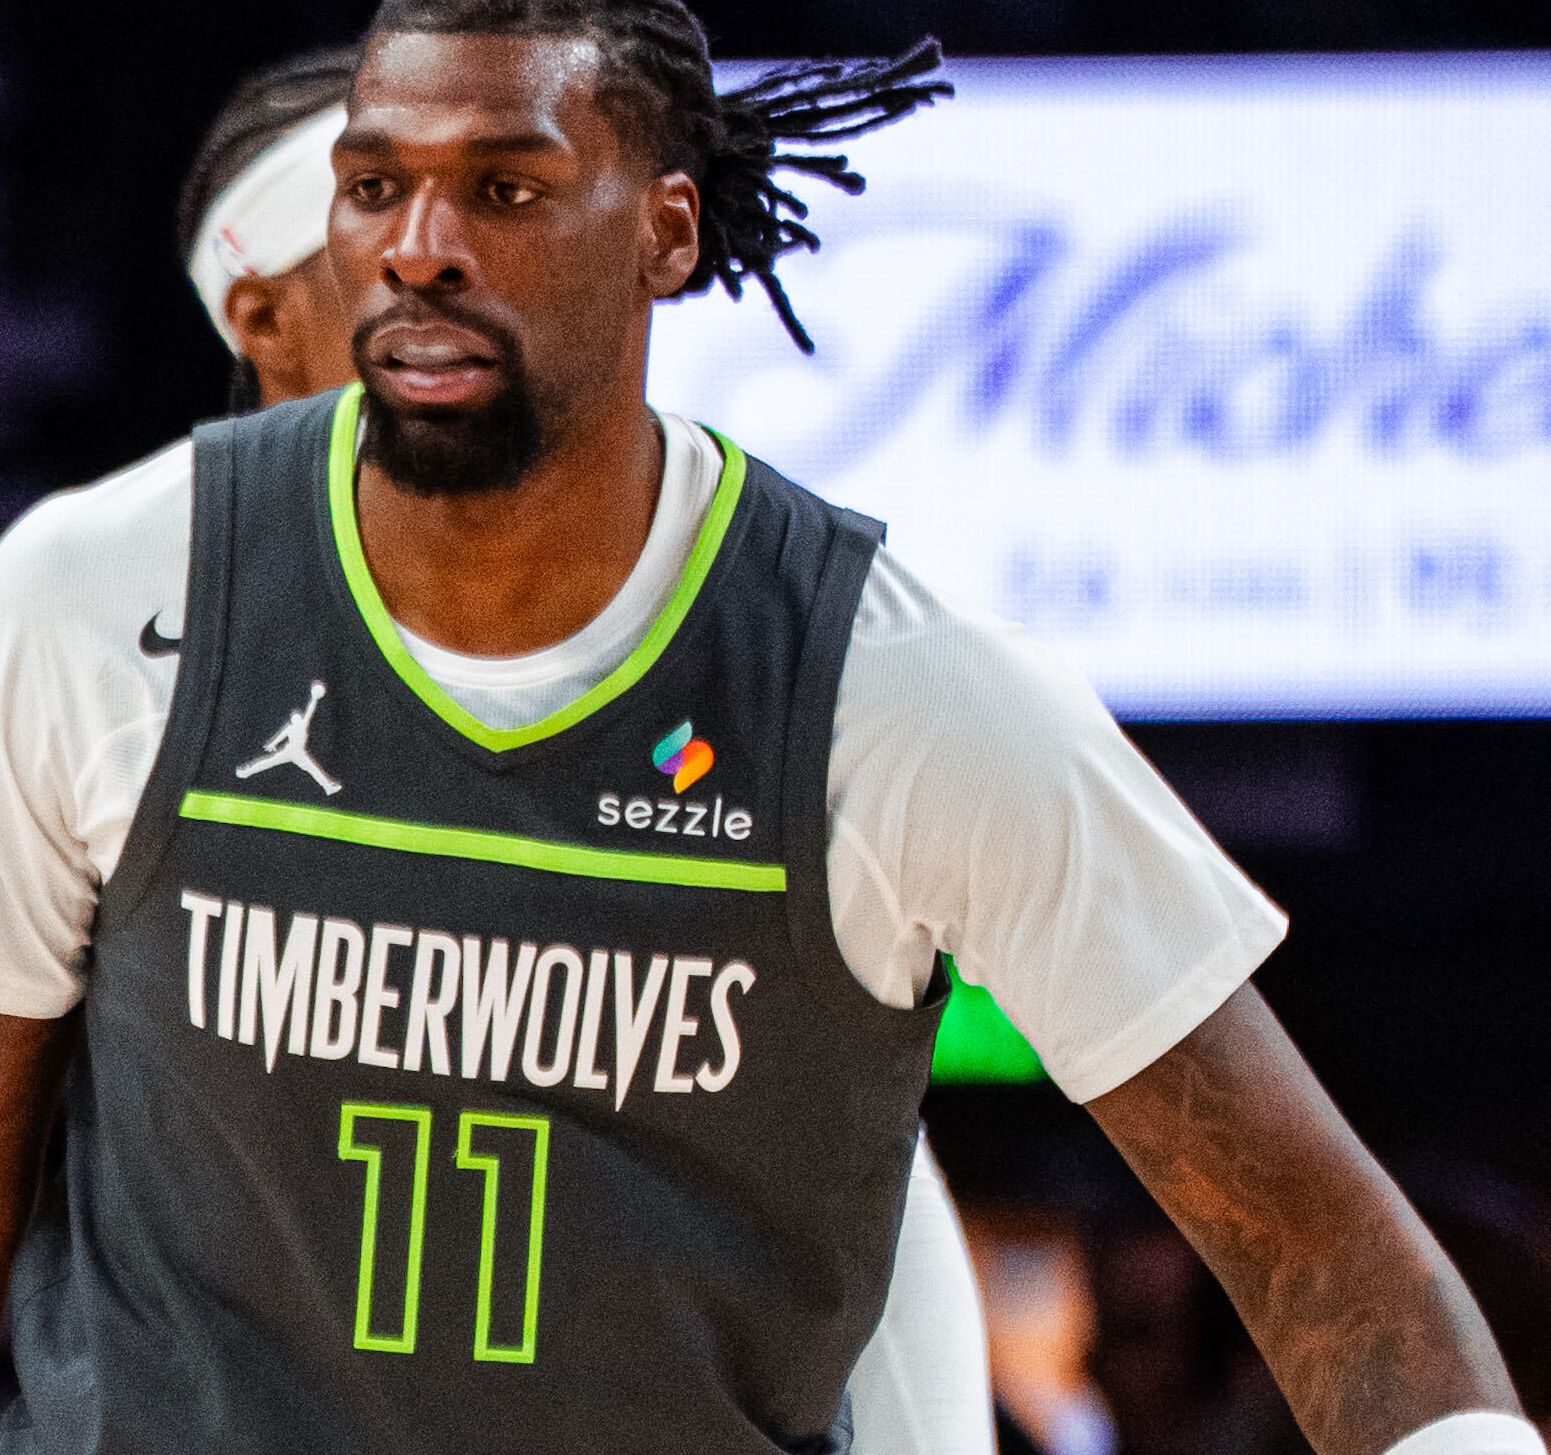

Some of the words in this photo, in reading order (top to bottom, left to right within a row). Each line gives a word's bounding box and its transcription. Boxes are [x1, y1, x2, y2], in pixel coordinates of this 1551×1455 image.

[597, 795, 753, 841] sezzle
[181, 890, 757, 1112] TIMBERWOLVES
[338, 1101, 550, 1364] 11
